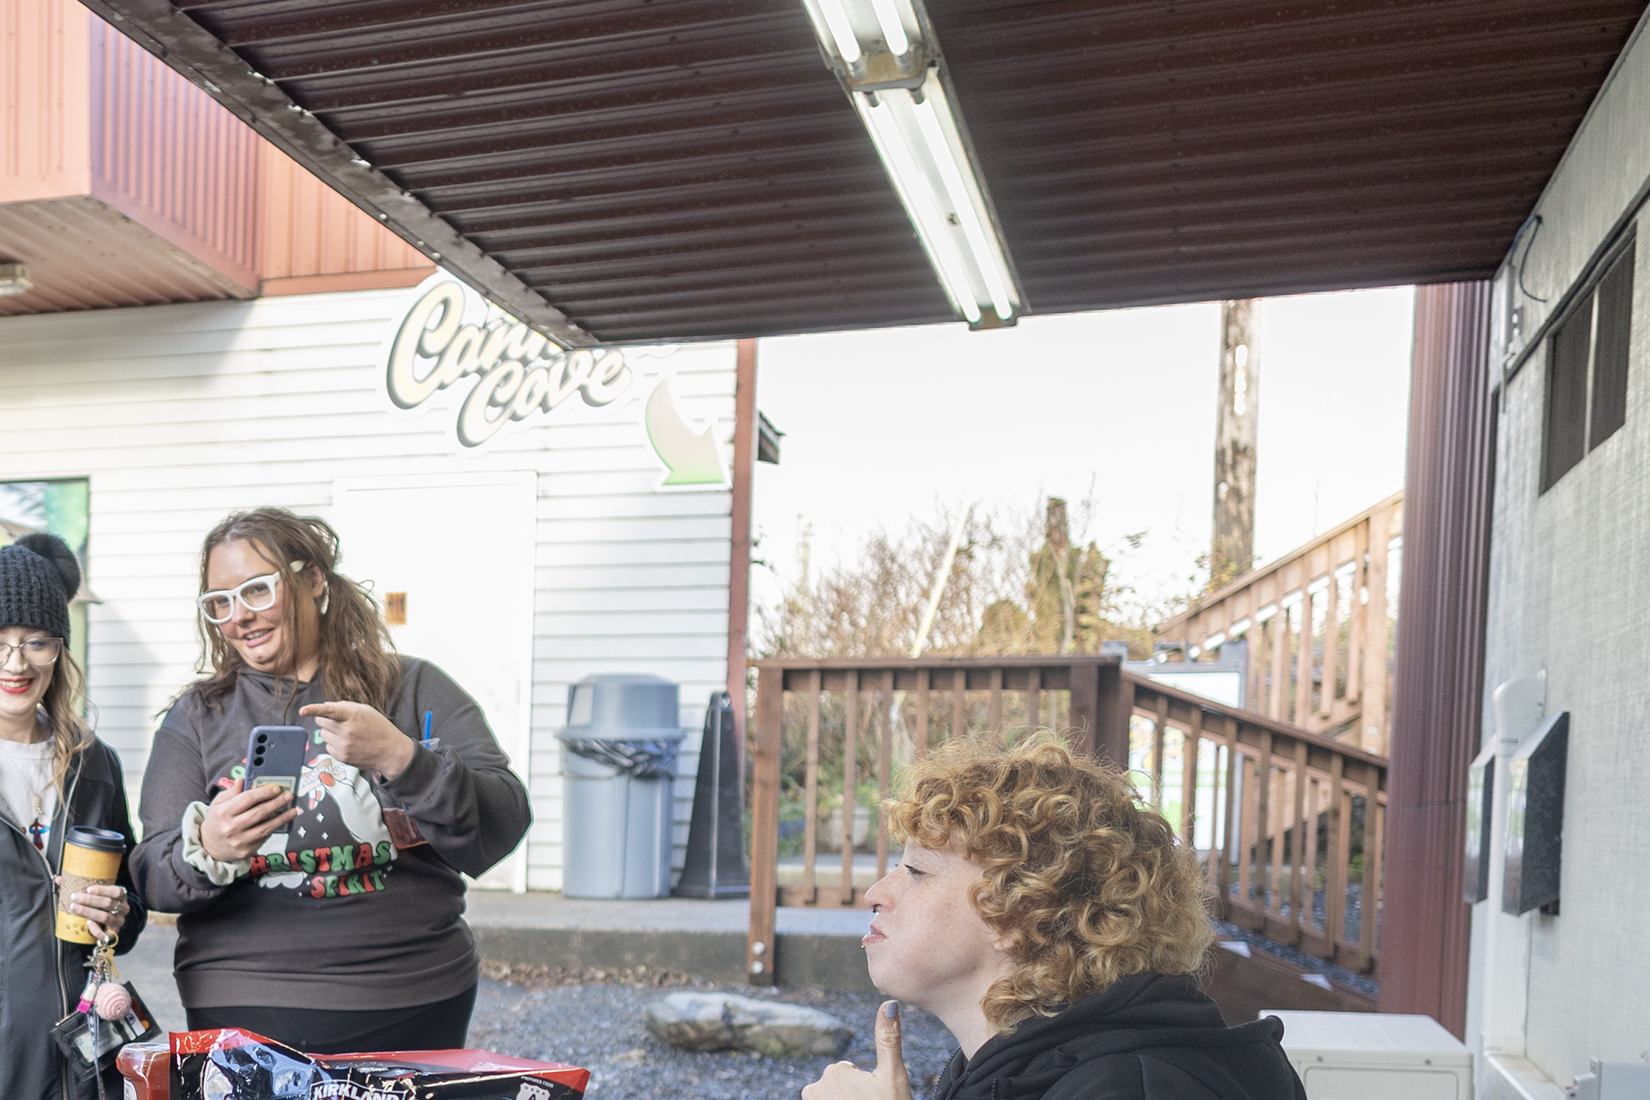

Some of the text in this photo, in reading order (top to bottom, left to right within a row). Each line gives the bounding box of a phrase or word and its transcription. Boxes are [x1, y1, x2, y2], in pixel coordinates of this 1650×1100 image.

[457, 350, 633, 448] Cove
[250, 841, 391, 877] HRISTMAS
[310, 869, 386, 899] SPIRIT
